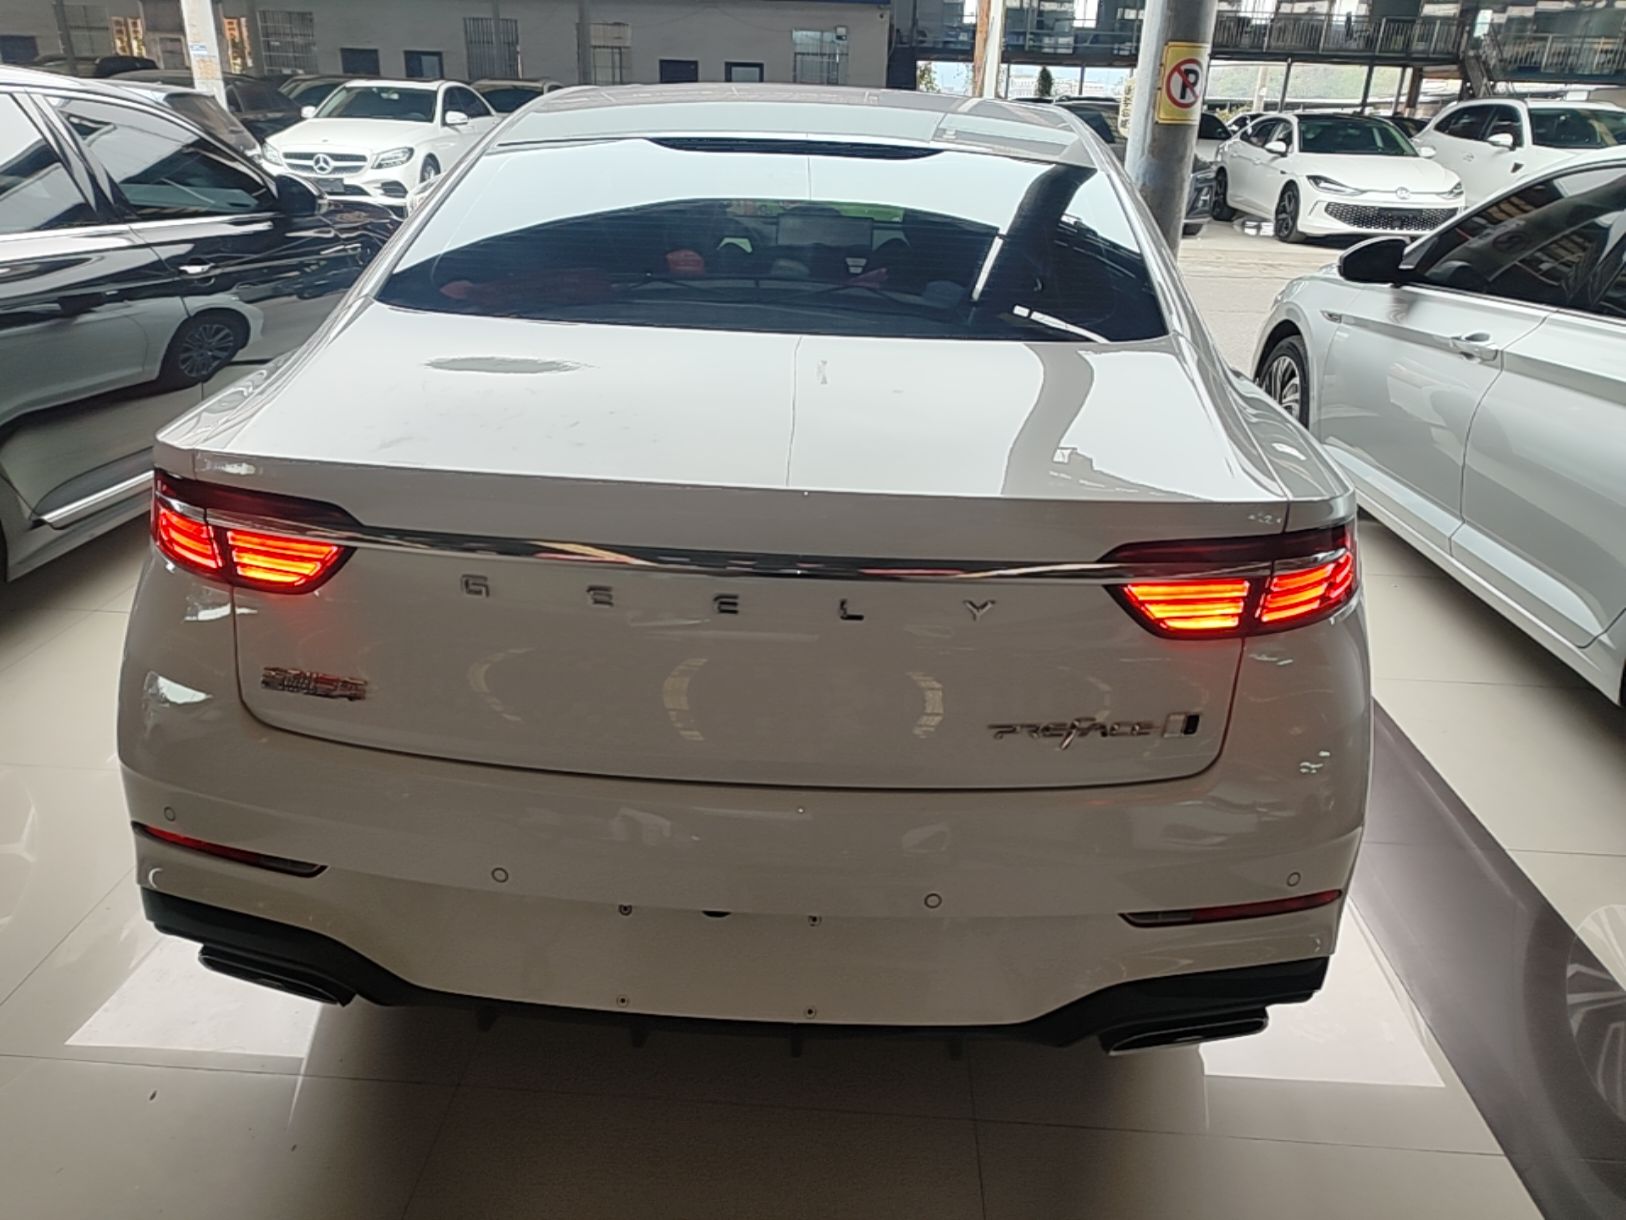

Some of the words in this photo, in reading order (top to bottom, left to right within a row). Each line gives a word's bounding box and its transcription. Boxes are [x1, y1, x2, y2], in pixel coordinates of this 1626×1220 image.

[1179, 67, 1200, 100] P
[461, 573, 995, 622] GEELY
[987, 716, 1156, 751] PREFACE
